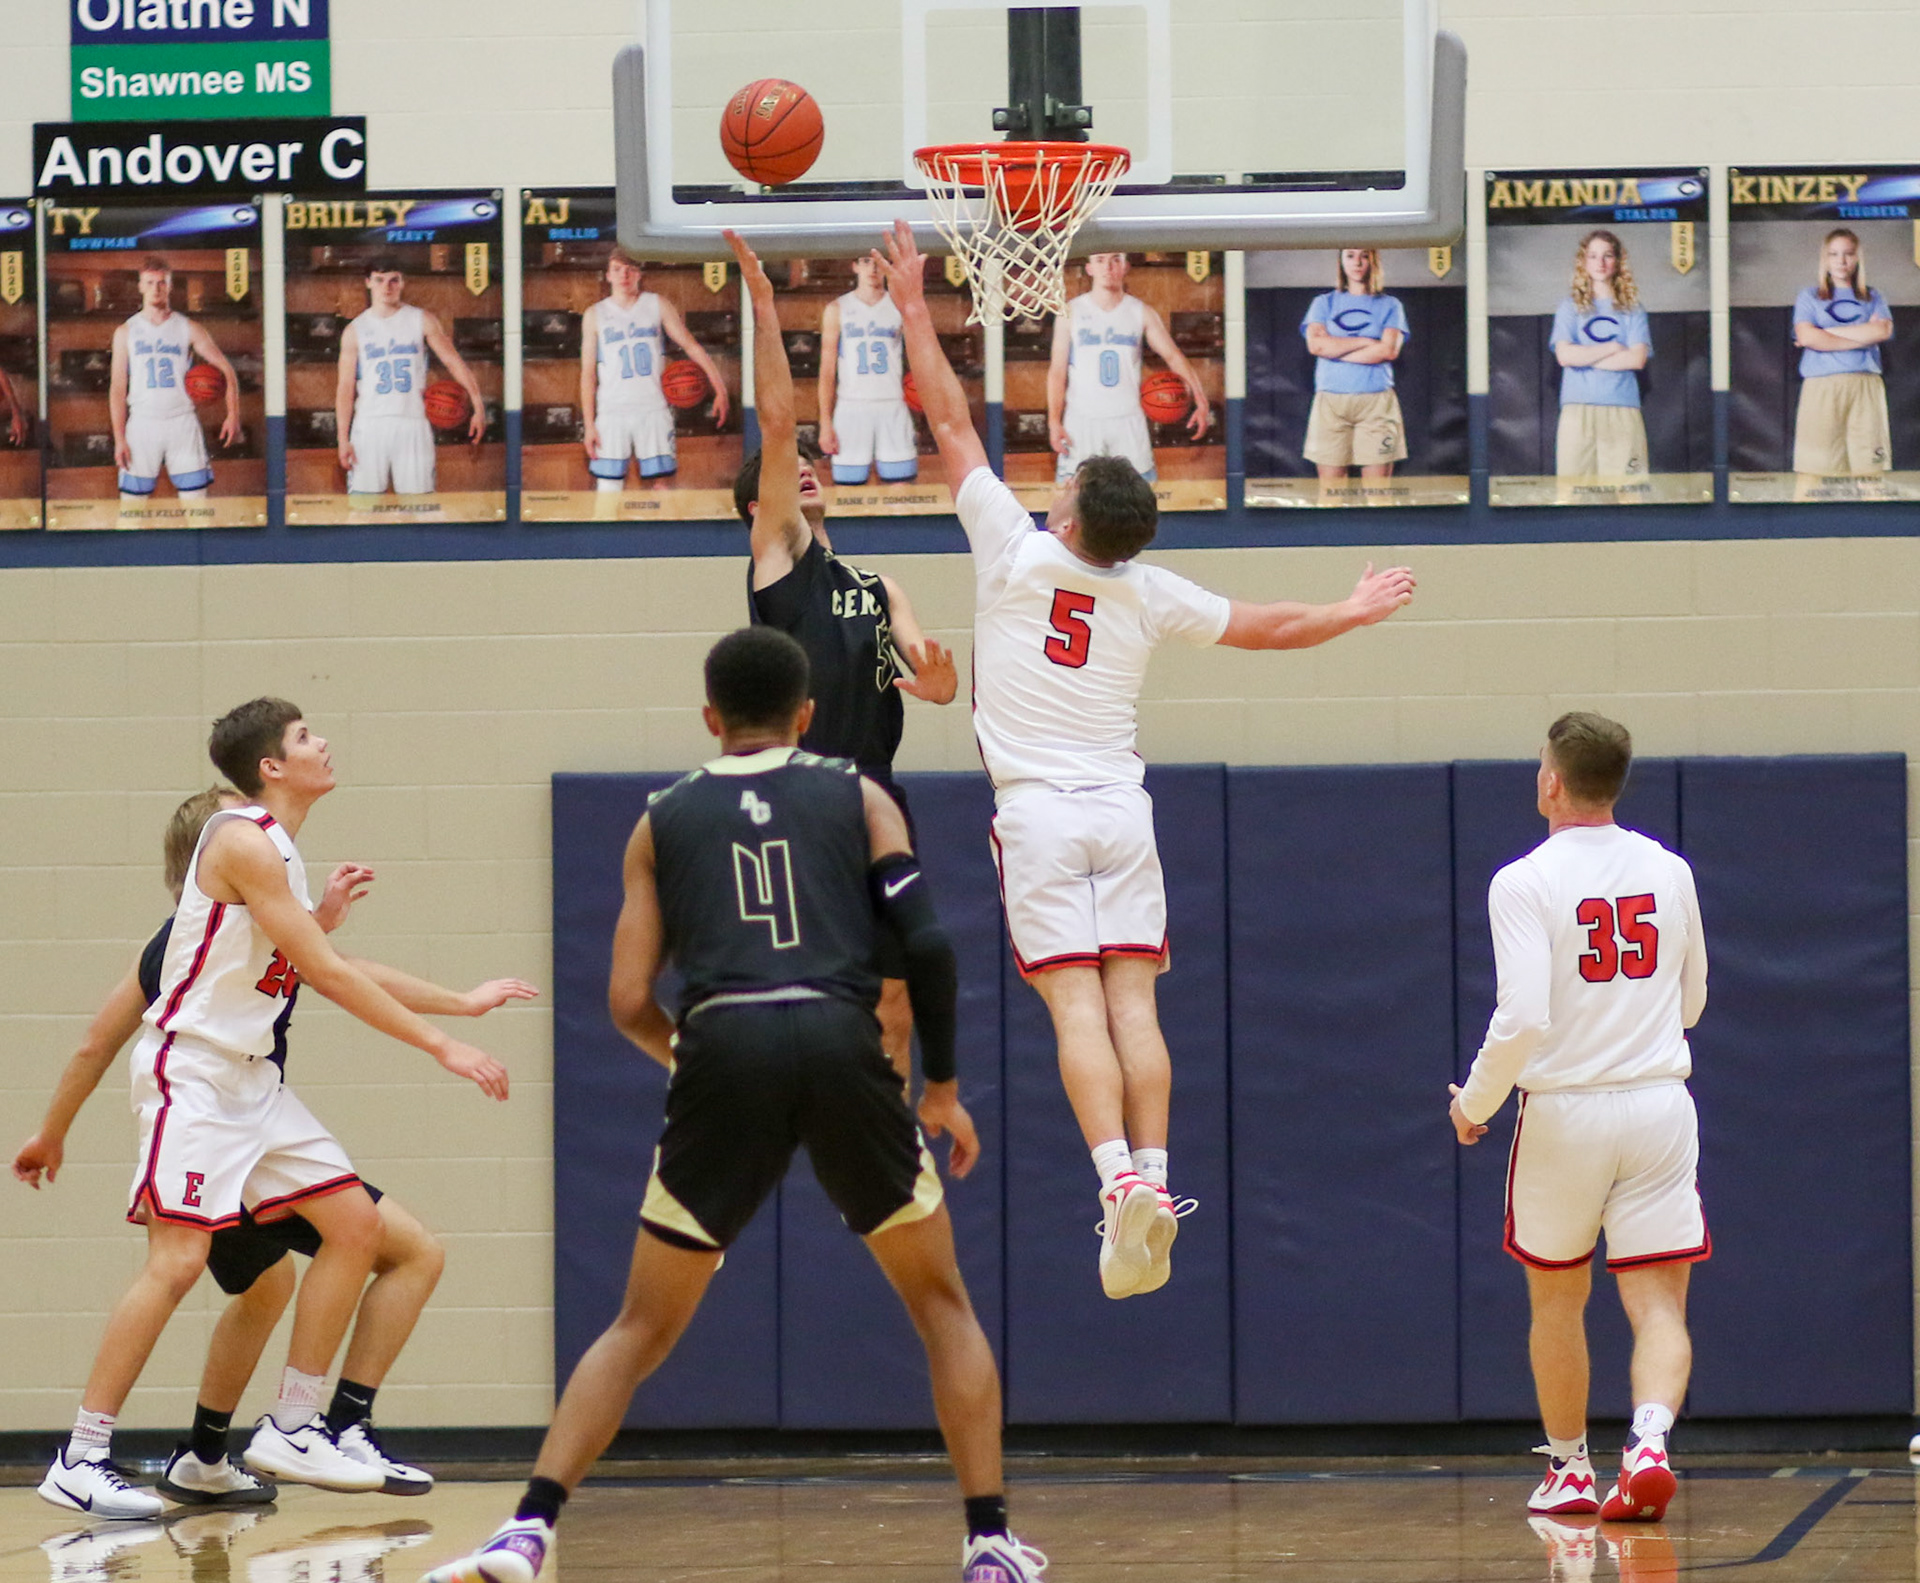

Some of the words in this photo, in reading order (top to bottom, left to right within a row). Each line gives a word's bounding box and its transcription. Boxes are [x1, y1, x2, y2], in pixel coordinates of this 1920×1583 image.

[77, 0, 254, 31] Olathe
[272, 0, 311, 28] N
[80, 67, 244, 98] Shawnee
[255, 61, 312, 93] MS
[37, 134, 303, 187] Andover
[320, 128, 365, 180] C
[1489, 178, 1643, 208] AMANDA
[1731, 175, 1868, 204] KINZEY
[48, 207, 100, 235] TY
[286, 200, 416, 229] BRILEY
[524, 198, 570, 225] AJ
[146, 357, 175, 389] 12
[618, 342, 652, 379] 10
[857, 341, 889, 374] 13
[1099, 350, 1119, 377] 0
[375, 358, 412, 395] 35
[836, 497, 862, 505] BANK
[882, 495, 937, 504] COMMERCE
[831, 588, 882, 619] CEN
[1044, 588, 1095, 669] 5
[732, 839, 800, 949] 4
[1576, 893, 1658, 983] 35
[182, 1171, 205, 1208] E
